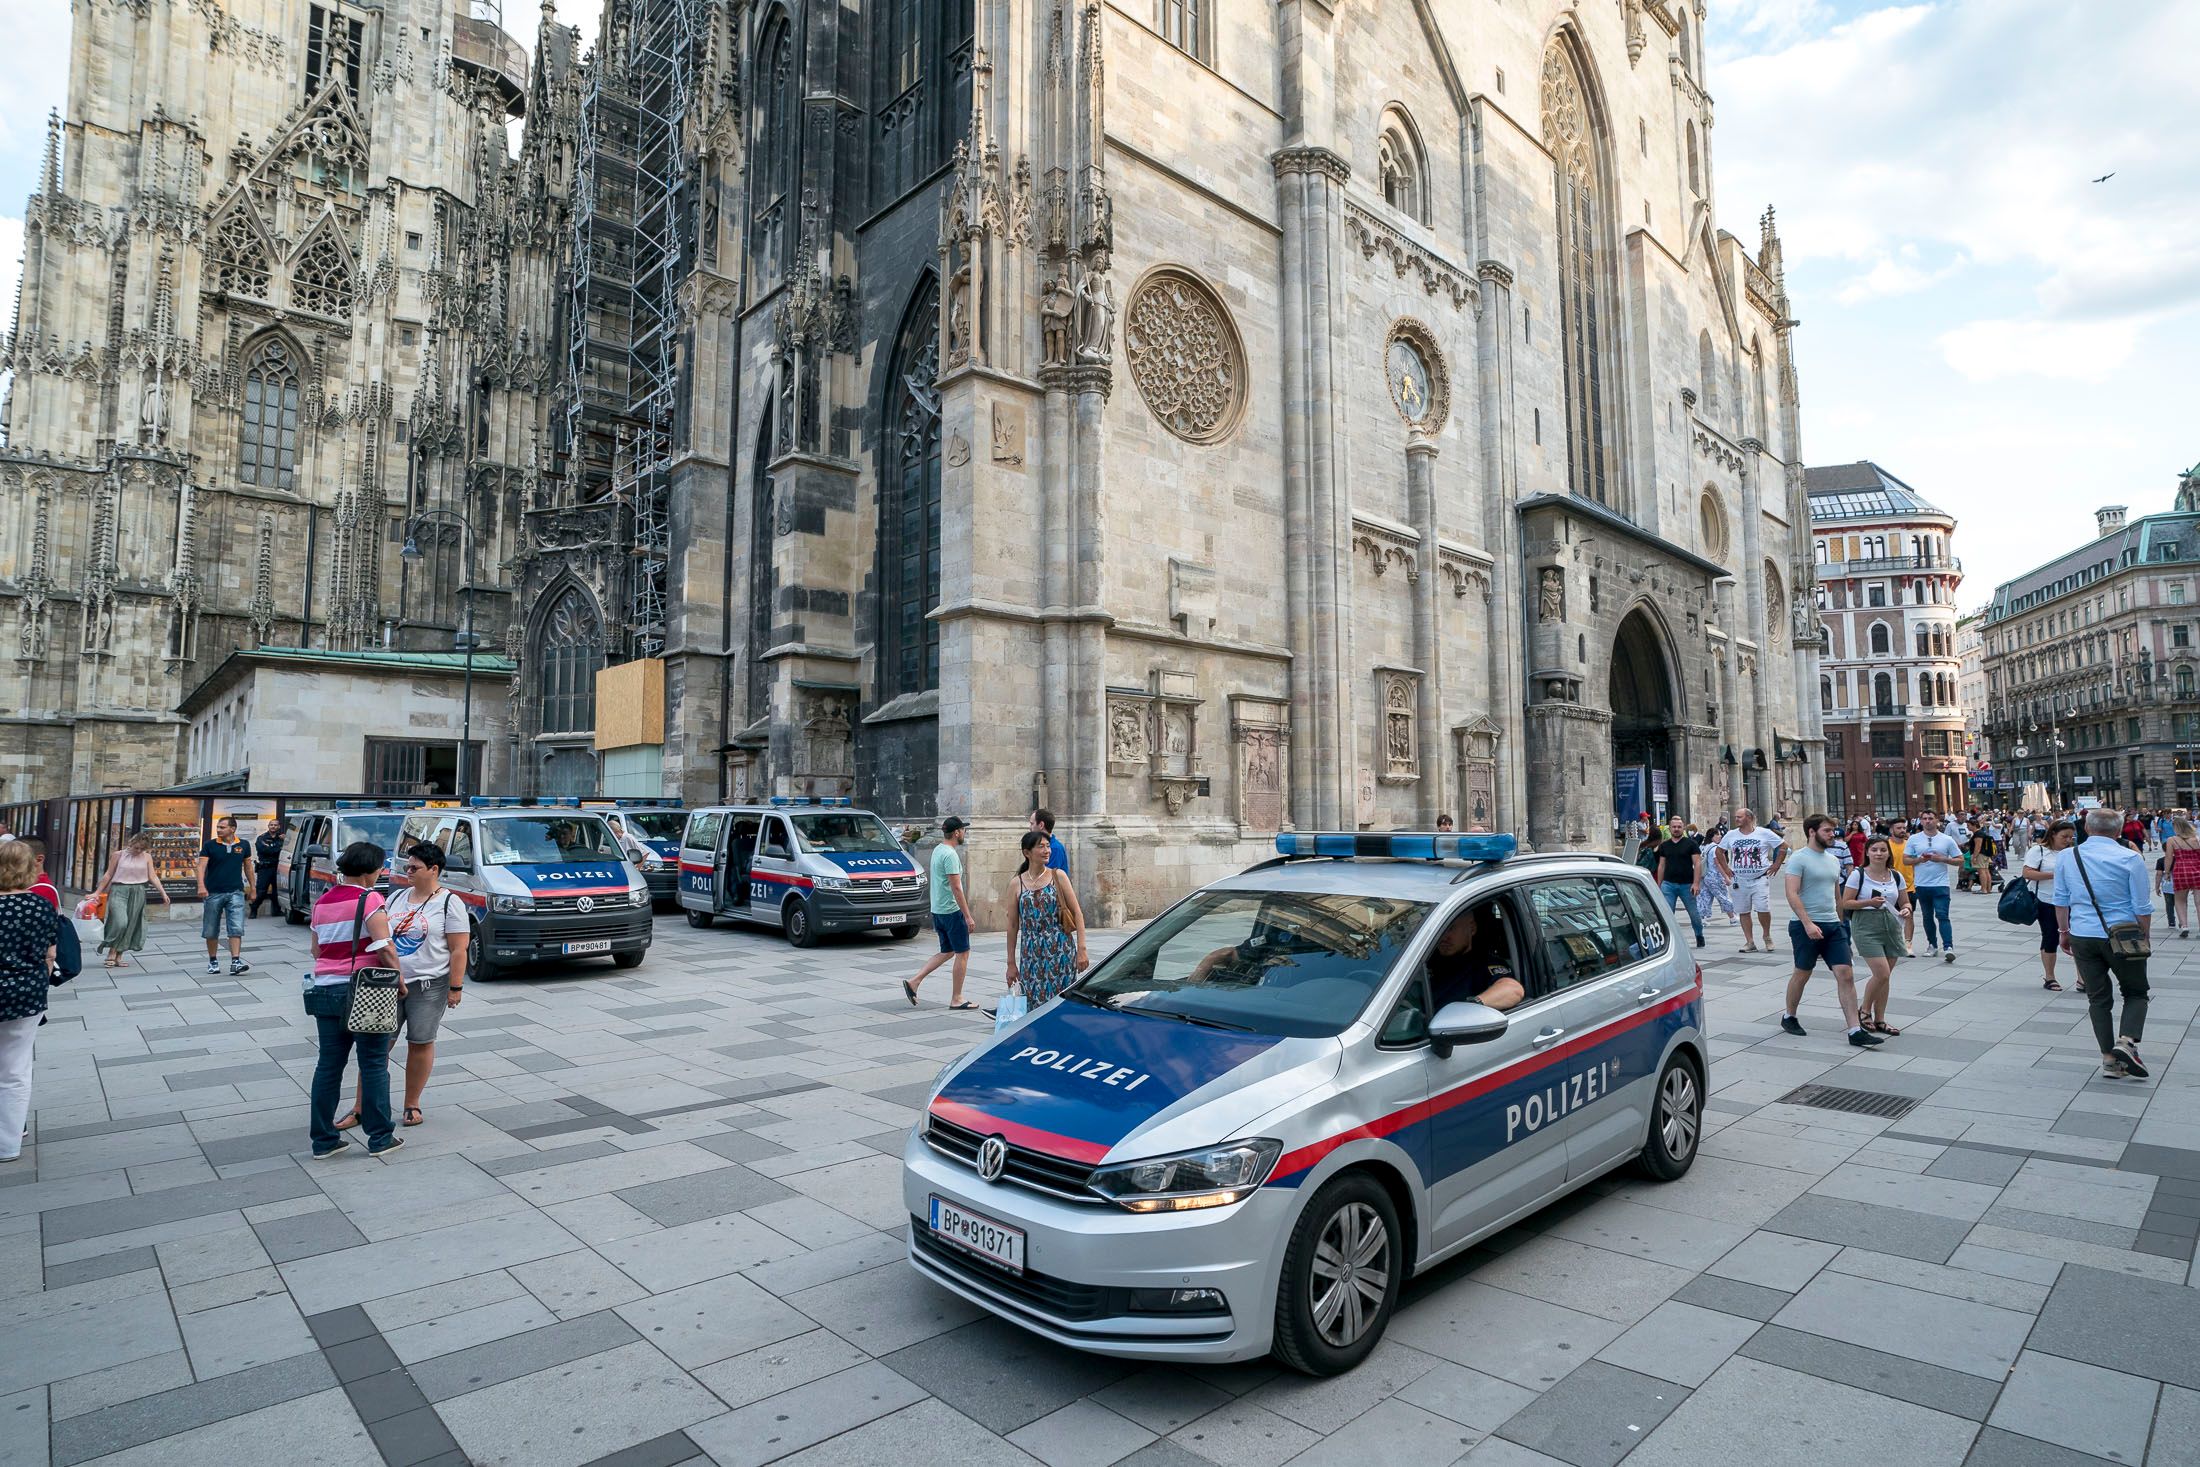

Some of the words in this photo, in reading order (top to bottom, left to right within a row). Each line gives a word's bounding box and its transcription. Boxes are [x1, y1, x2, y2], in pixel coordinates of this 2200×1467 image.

[848, 858, 903, 867] POLIZEI
[536, 871, 614, 882] POLIZEI
[692, 875, 712, 891] POLI
[751, 882, 767, 899] ZEI
[1645, 921, 1665, 949] 133
[586, 942, 608, 951] 90481
[1009, 1046, 1150, 1091] POLIZEI
[1506, 1061, 1607, 1143] POLIZEI
[970, 1221, 1013, 1260] 91371
